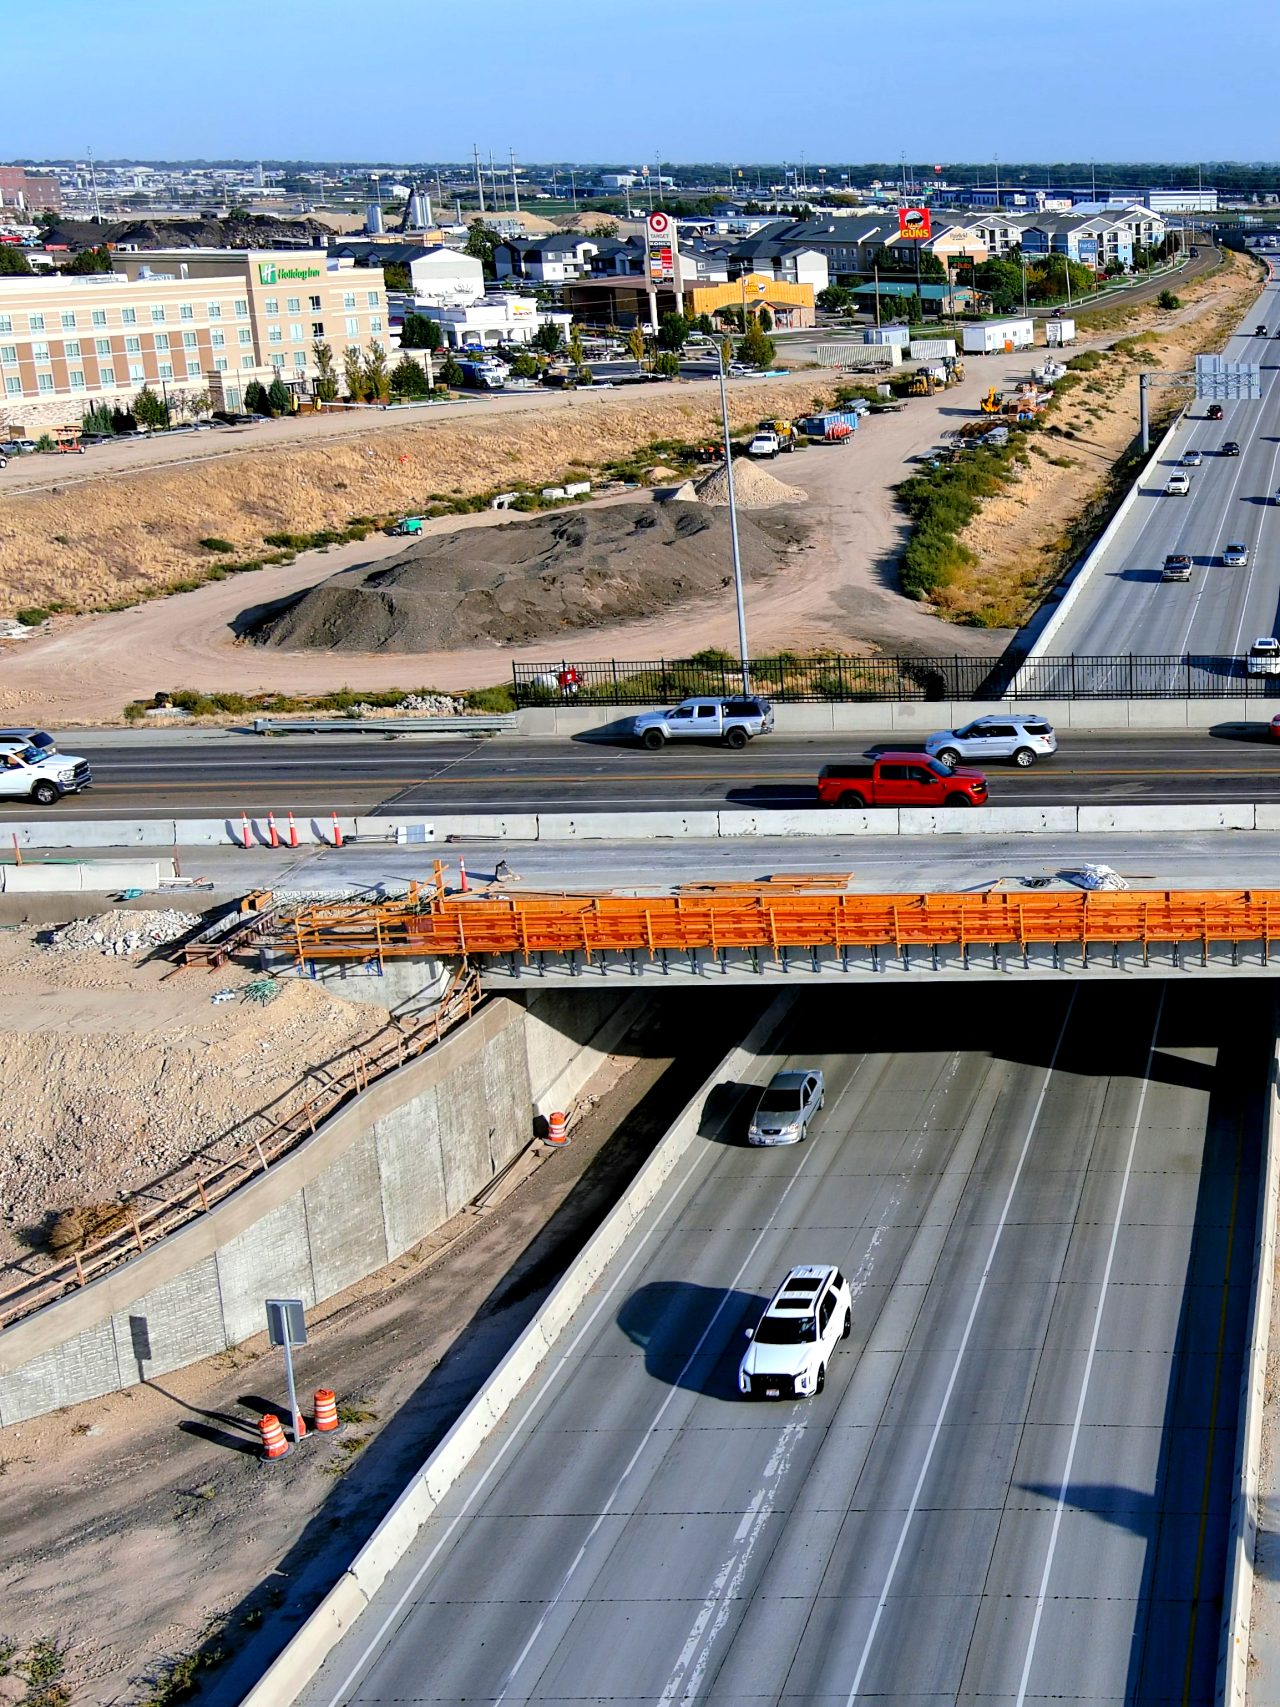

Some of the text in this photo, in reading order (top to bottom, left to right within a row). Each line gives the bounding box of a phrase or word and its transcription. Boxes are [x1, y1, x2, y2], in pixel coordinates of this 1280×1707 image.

[901, 229, 929, 238] GUNS
[278, 268, 307, 280] Holiday
[308, 266, 320, 278] Inn
